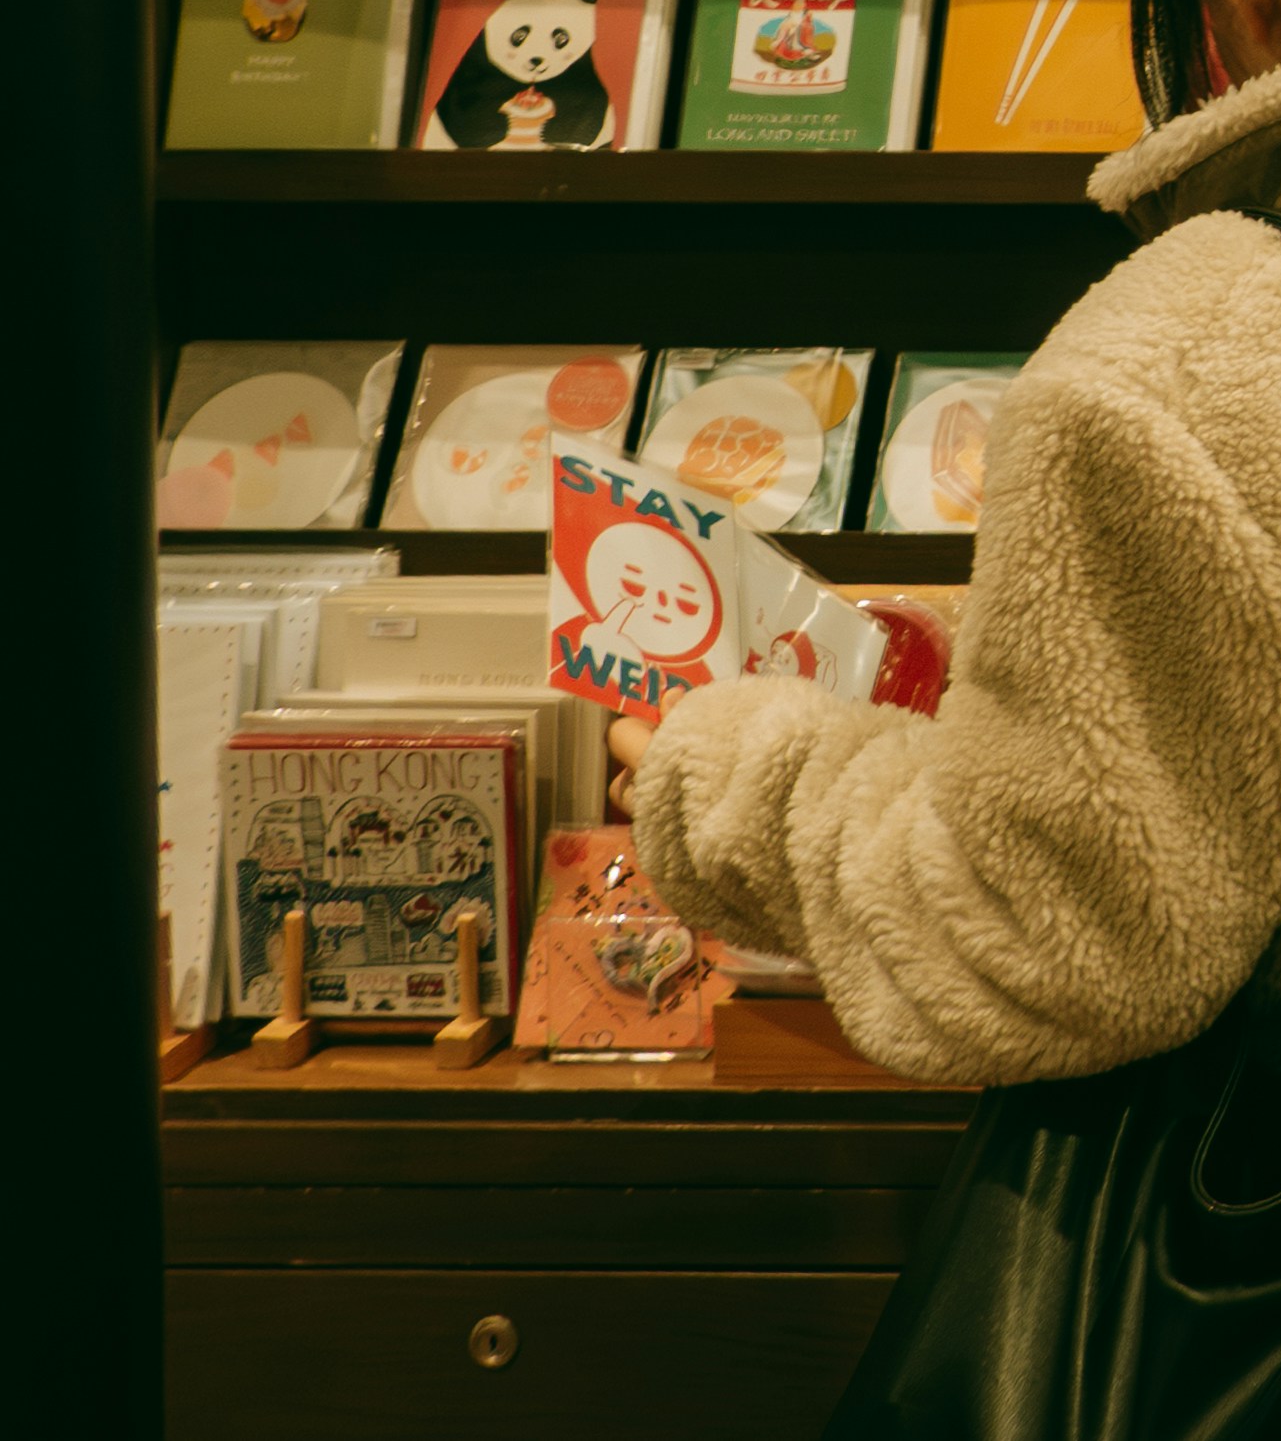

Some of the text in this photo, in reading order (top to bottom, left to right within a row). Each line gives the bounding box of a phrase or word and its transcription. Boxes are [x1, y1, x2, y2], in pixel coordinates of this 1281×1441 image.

[559, 453, 726, 540] STAY
[249, 750, 483, 795] HONG KONG
